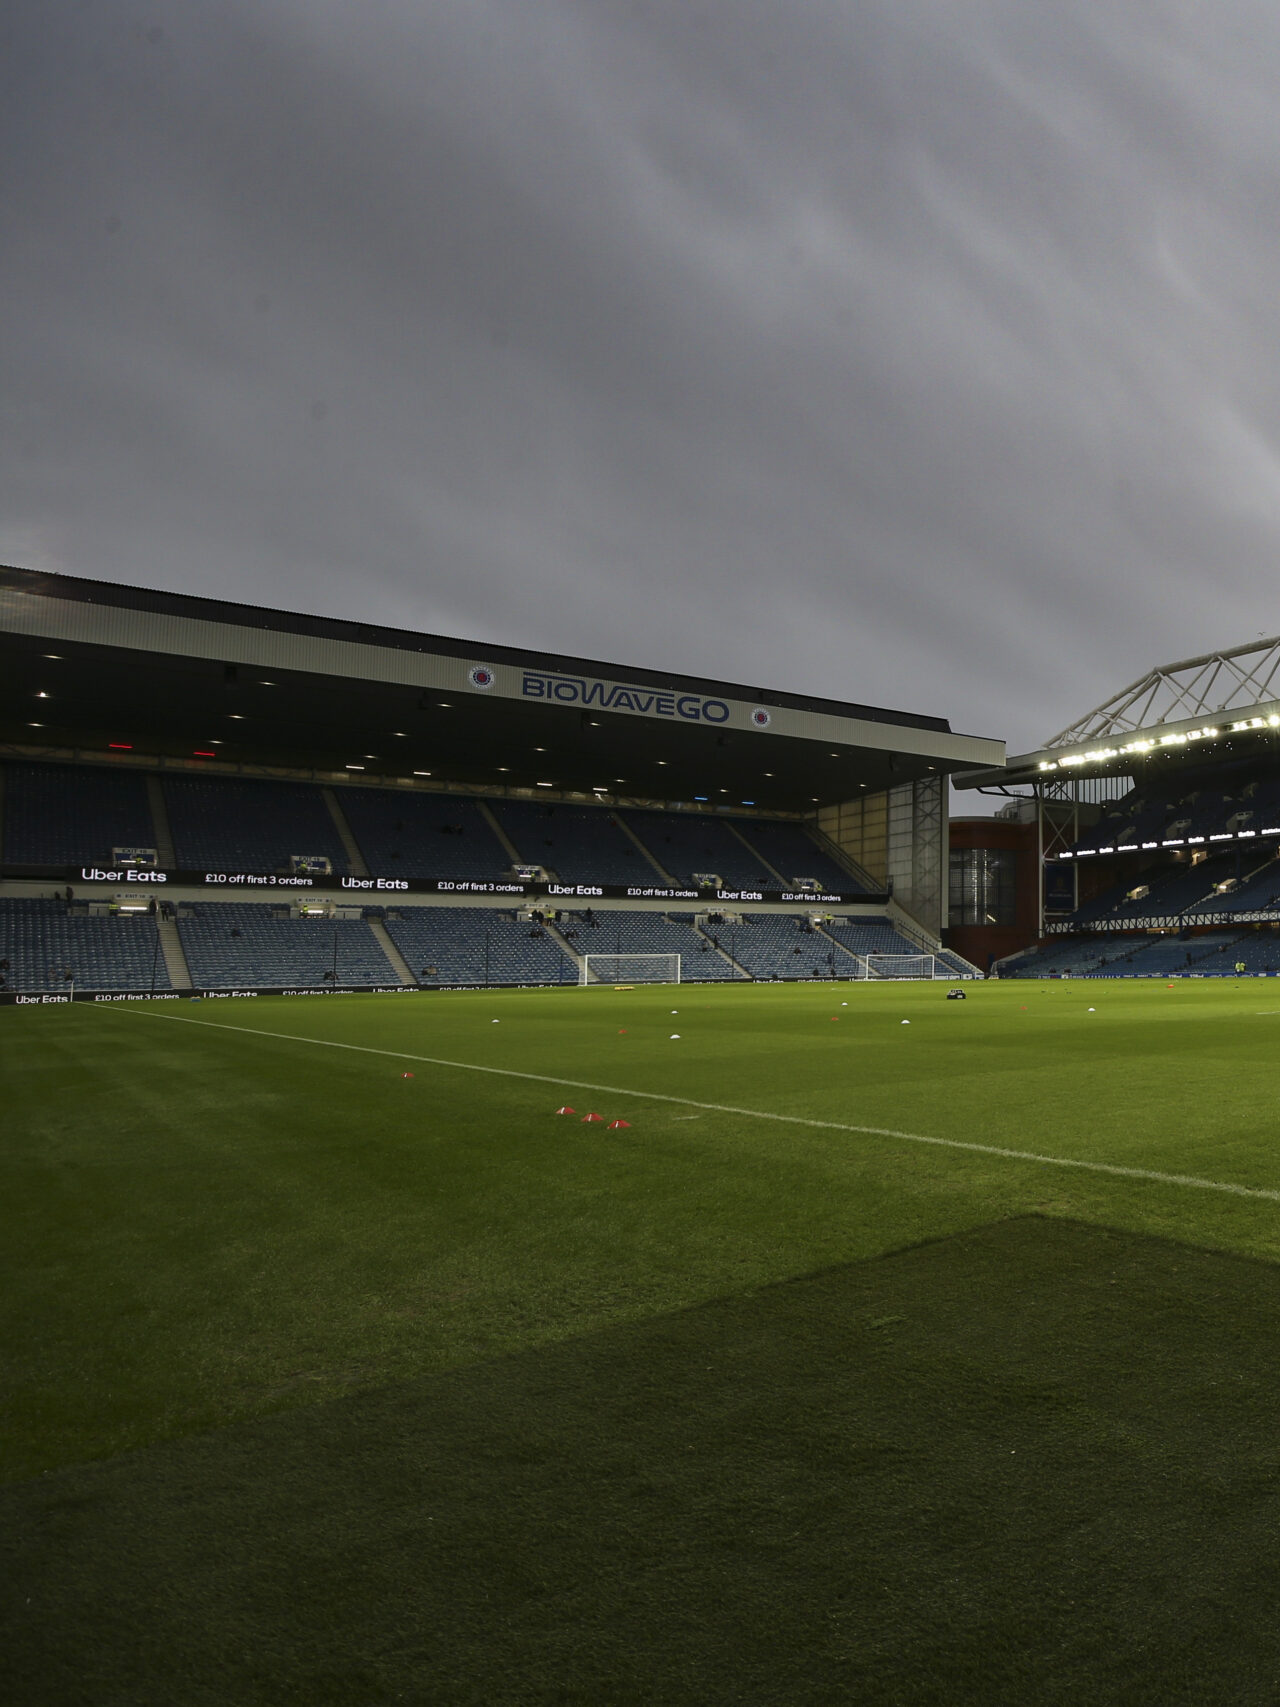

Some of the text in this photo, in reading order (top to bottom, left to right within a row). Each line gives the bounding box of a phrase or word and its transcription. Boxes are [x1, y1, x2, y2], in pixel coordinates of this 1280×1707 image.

[82, 868, 166, 882] Uber Eats
[206, 874, 312, 885] £10 off first 3 orders
[342, 878, 408, 889] Uber Eats
[548, 884, 602, 895] Uber Eats
[717, 890, 762, 900] Uber Eats
[16, 995, 68, 1004] Uber Eats
